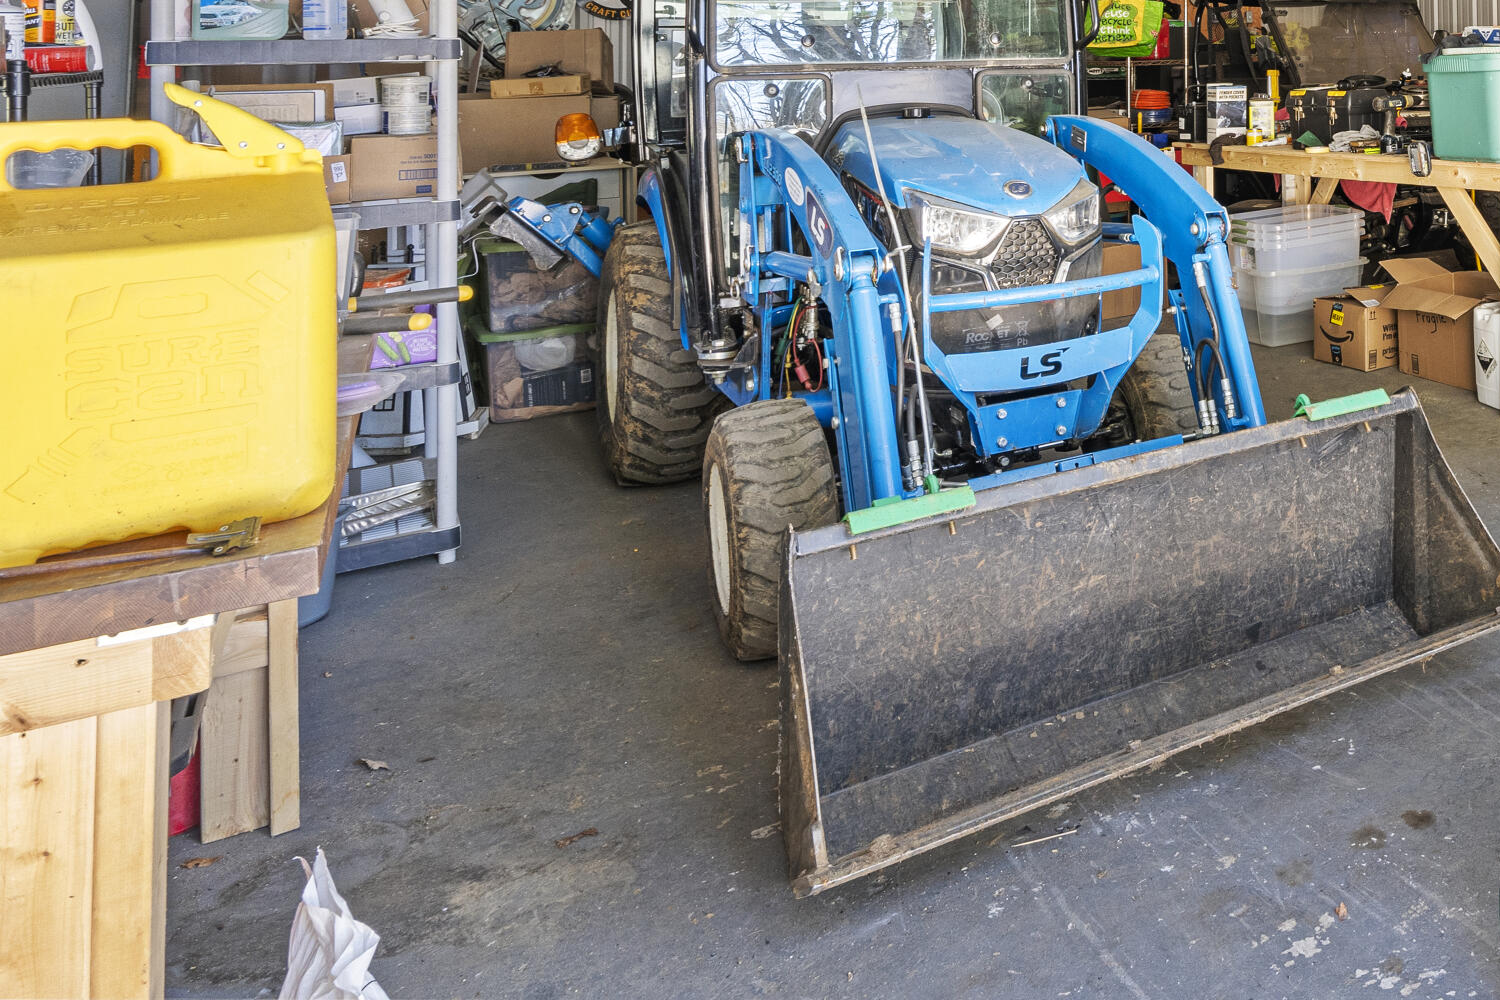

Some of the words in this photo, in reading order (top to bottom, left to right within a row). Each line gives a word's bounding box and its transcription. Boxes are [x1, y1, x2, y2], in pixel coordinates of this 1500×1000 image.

[585, 2, 617, 17] CRAFT
[1105, 9, 1130, 18] euse
[1100, 26, 1130, 34] ethink
[811, 206, 825, 246] LS
[1332, 313, 1344, 321] HEAVY
[1416, 310, 1447, 334] Fragile
[1016, 337, 1029, 347] Pb
[1020, 350, 1064, 380] LS
